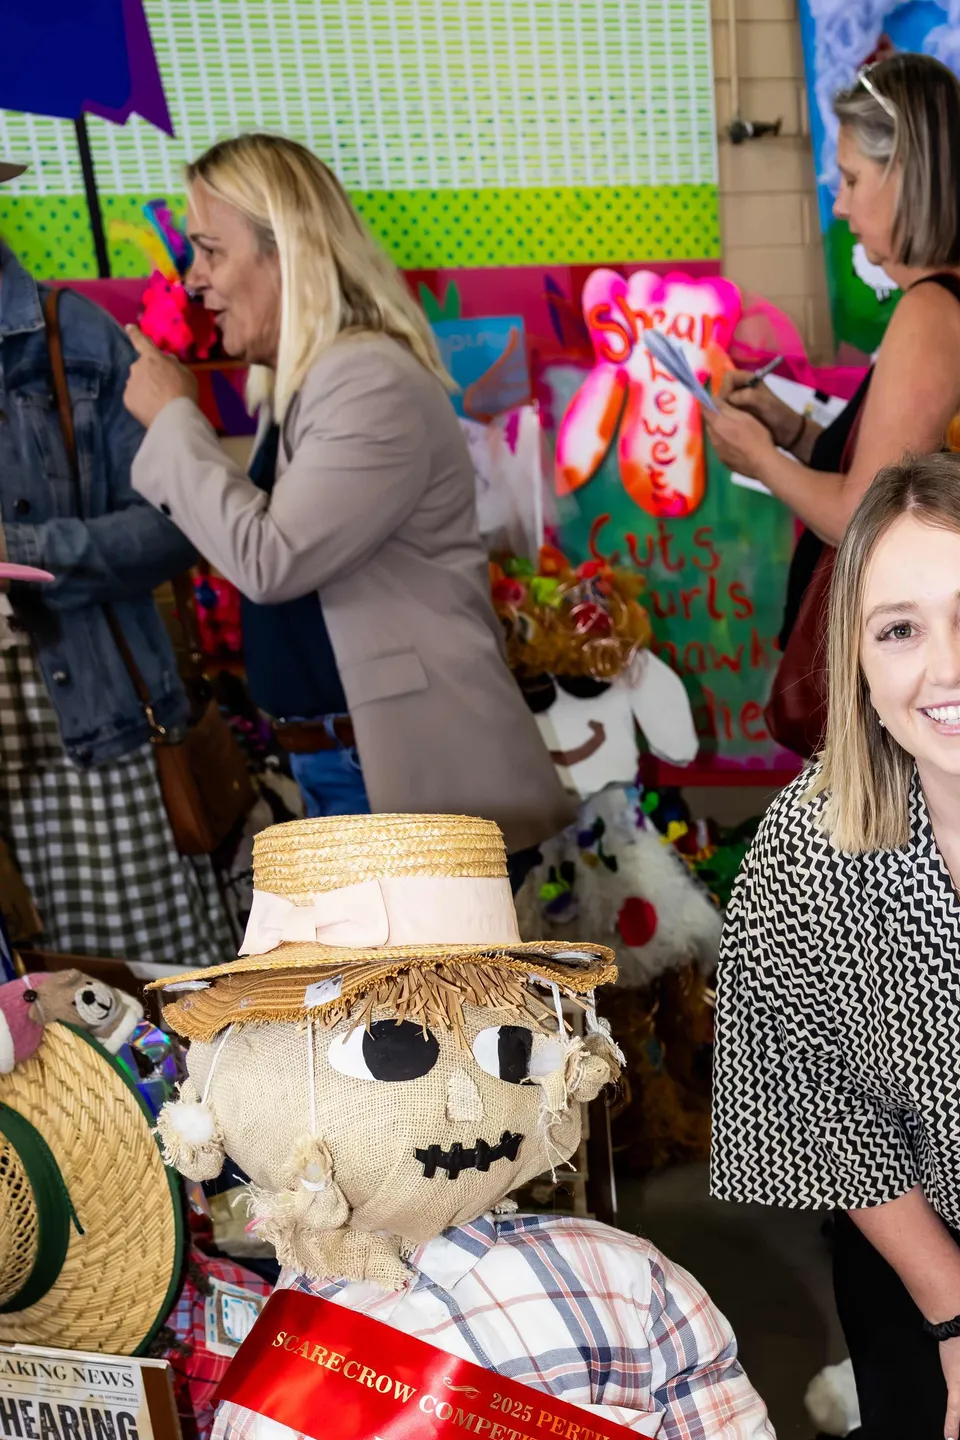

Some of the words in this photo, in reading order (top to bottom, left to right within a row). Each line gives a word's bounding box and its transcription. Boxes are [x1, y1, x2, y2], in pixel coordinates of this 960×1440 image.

[588, 513, 722, 572] Cuts
[651, 574, 755, 621] urls
[0, 1359, 67, 1382] AKING
[71, 1366, 135, 1389] NEWS
[271, 1330, 418, 1405] SCARECROW
[489, 1392, 533, 1424] 2025
